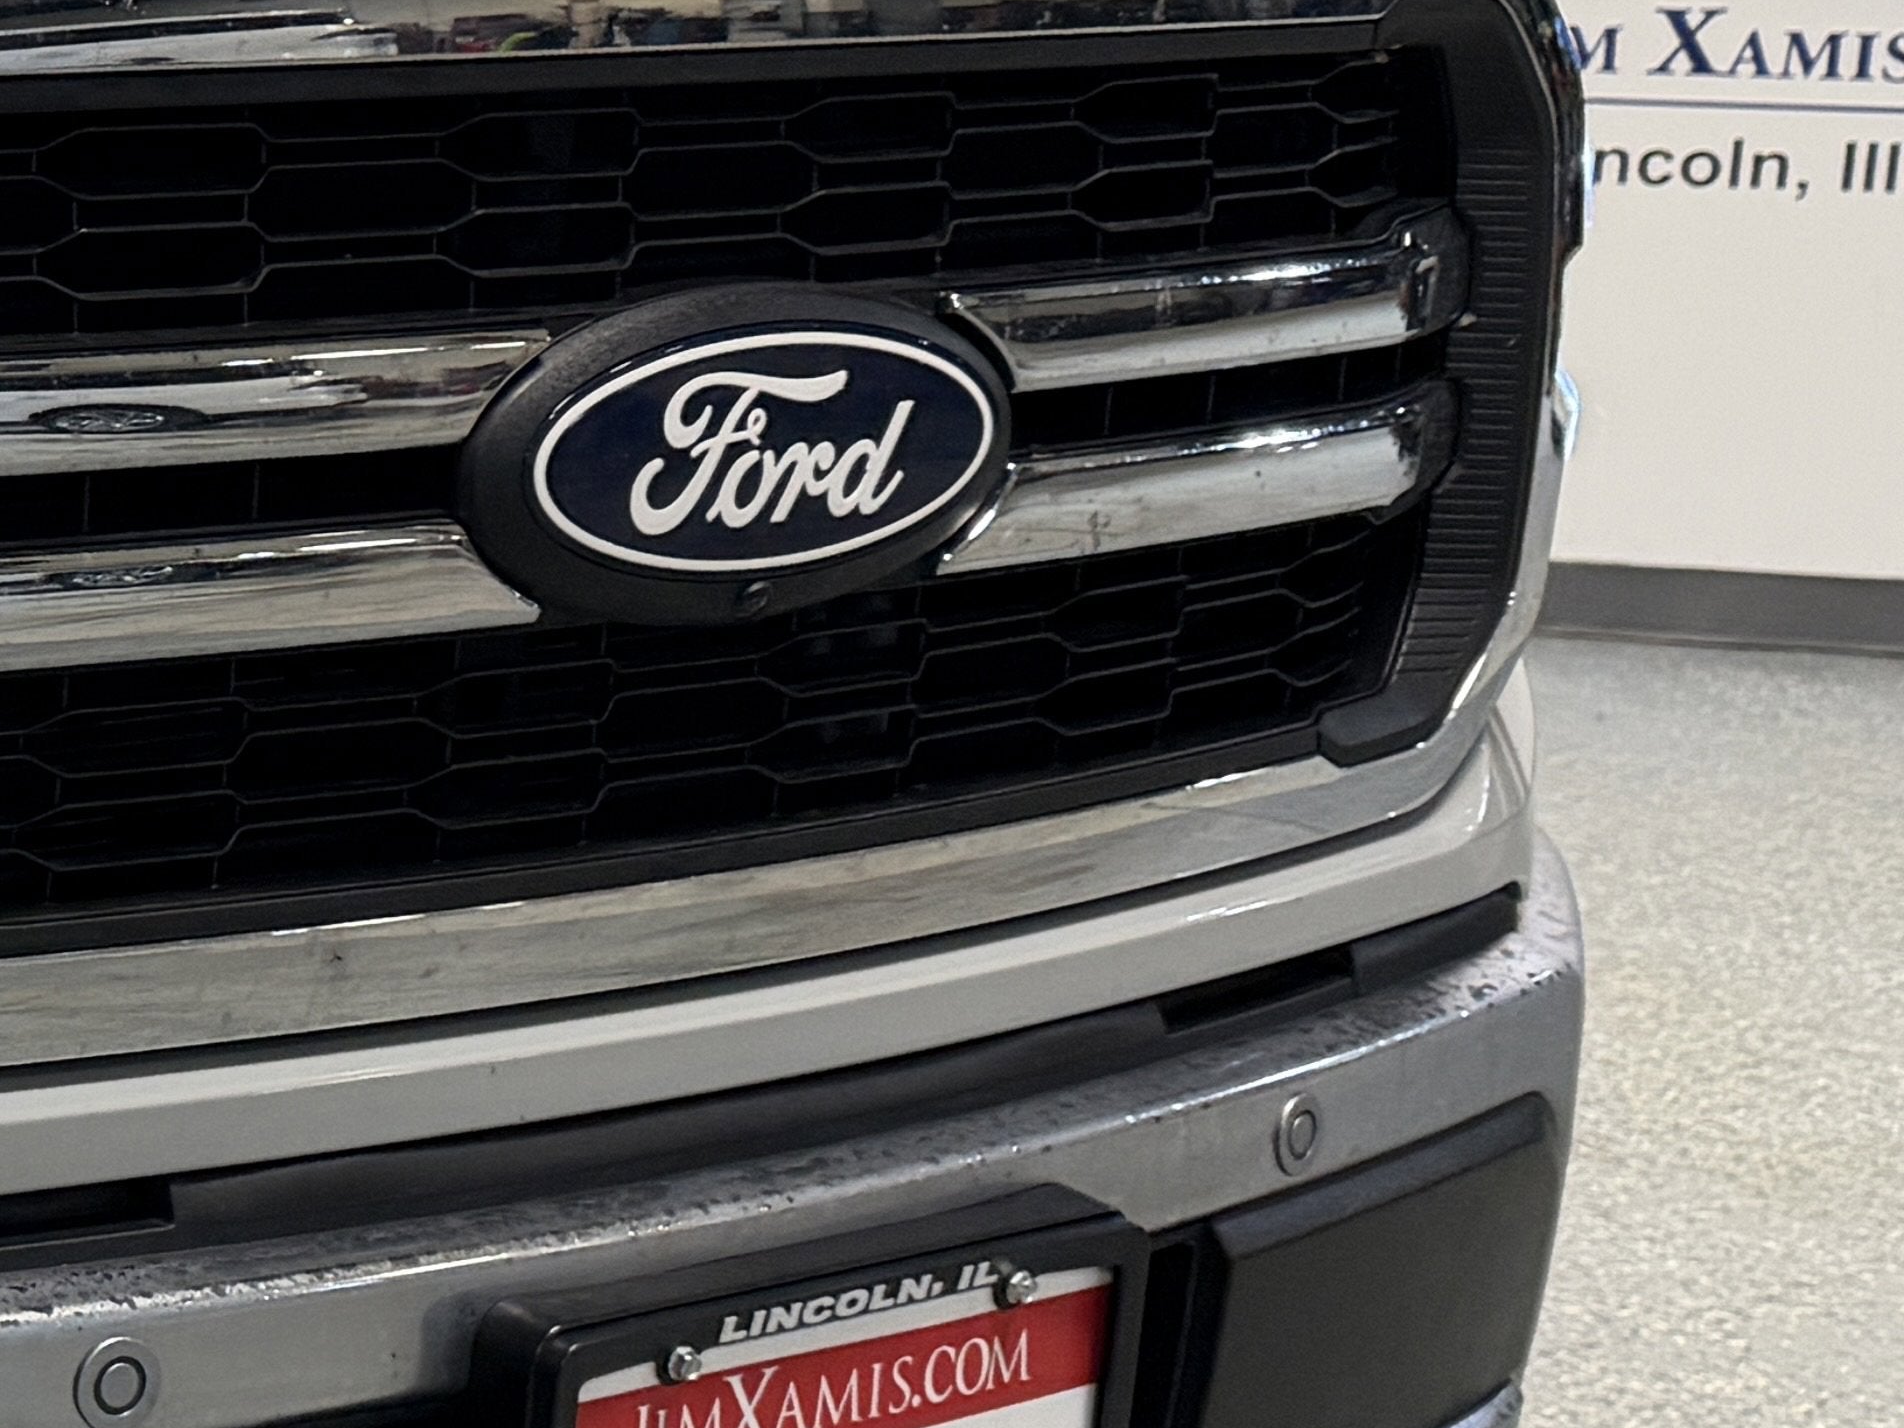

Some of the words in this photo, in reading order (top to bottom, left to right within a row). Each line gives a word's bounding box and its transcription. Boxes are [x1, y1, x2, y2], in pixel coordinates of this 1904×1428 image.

[1593, 136, 1810, 202] ncoln,
[629, 369, 917, 537] Ford
[718, 1273, 944, 1344] LINCOLN,
[957, 1260, 999, 1291] IL
